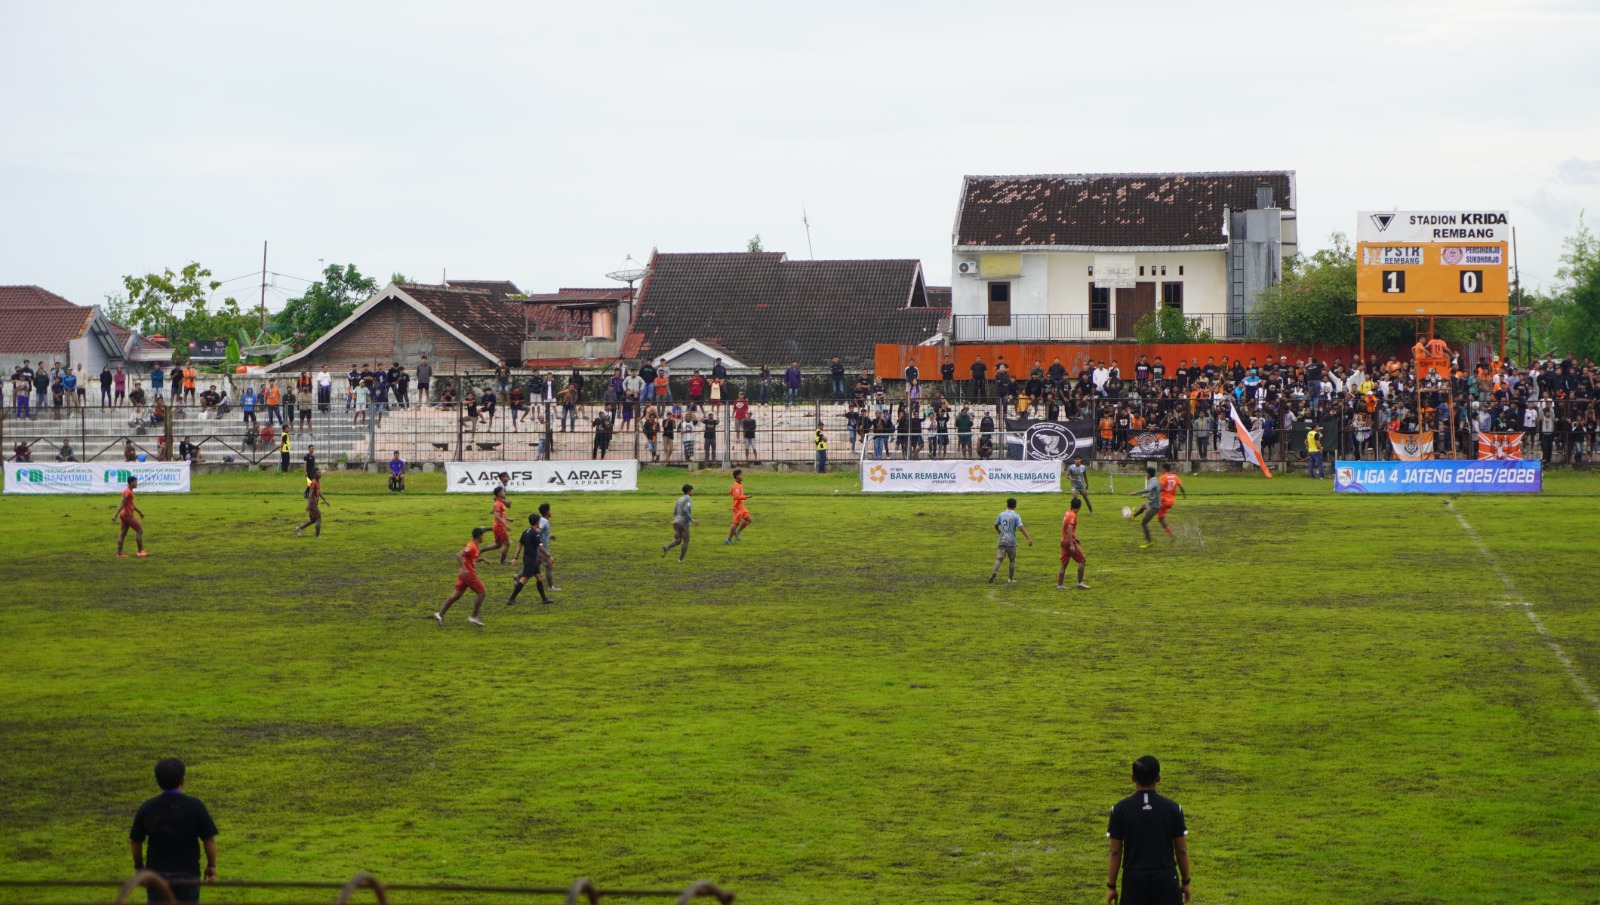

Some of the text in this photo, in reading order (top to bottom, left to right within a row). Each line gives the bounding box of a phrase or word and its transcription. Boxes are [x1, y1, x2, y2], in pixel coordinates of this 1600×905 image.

[1409, 213, 1508, 225] STADION KRIDA
[1433, 228, 1494, 238] REMBANG
[1384, 257, 1420, 265] REMBANG
[1465, 255, 1500, 264] SUKOHARJO
[1387, 272, 1400, 293] 1
[1463, 271, 1477, 293] 0
[44, 474, 93, 482] BANYUMILI
[478, 471, 533, 481] ARFS
[567, 470, 622, 480] ARAFS
[890, 472, 956, 480] BANK REMBANG
[988, 472, 1056, 481] BANK REMBANG
[1356, 468, 1536, 484] LIGA 4 JATENG 2025/2026
